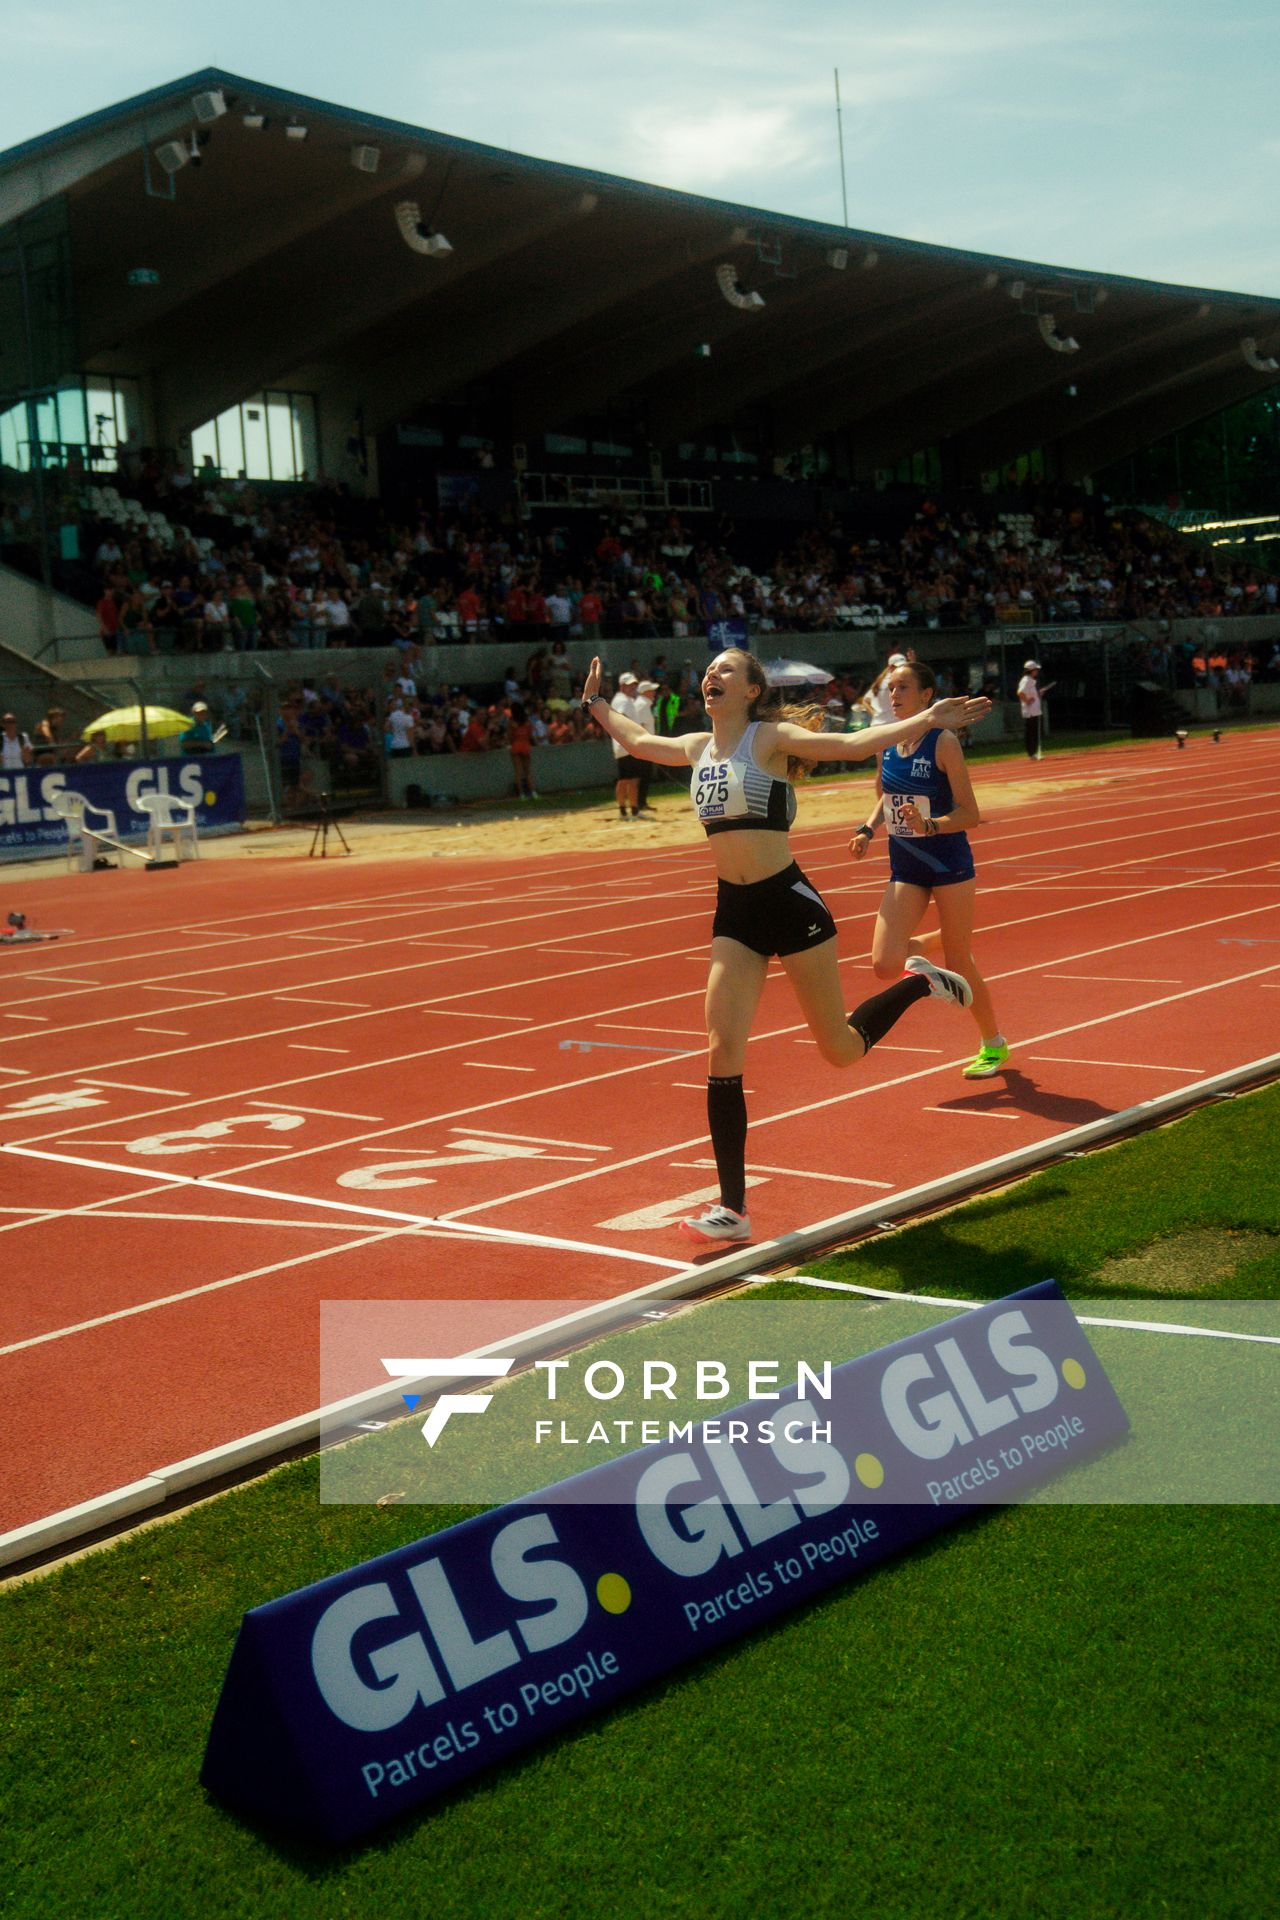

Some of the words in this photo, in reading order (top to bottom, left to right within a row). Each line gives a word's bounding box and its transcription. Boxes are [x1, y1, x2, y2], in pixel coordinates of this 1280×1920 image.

[912, 762, 932, 774] LAC
[696, 781, 729, 806] 675
[708, 805, 724, 813] PLAN
[891, 809, 905, 825] 19
[125, 1113, 306, 1155] 3
[336, 1139, 547, 1190] 2
[927, 1452, 1000, 1506] Parcels
[1000, 1444, 1023, 1469] to
[1020, 1413, 1086, 1462] People
[683, 1572, 774, 1632] Parcels
[774, 1556, 803, 1586] to
[800, 1515, 880, 1570] People
[361, 1720, 481, 1798] Parcels
[484, 1702, 519, 1735] to
[518, 1647, 621, 1717] People
